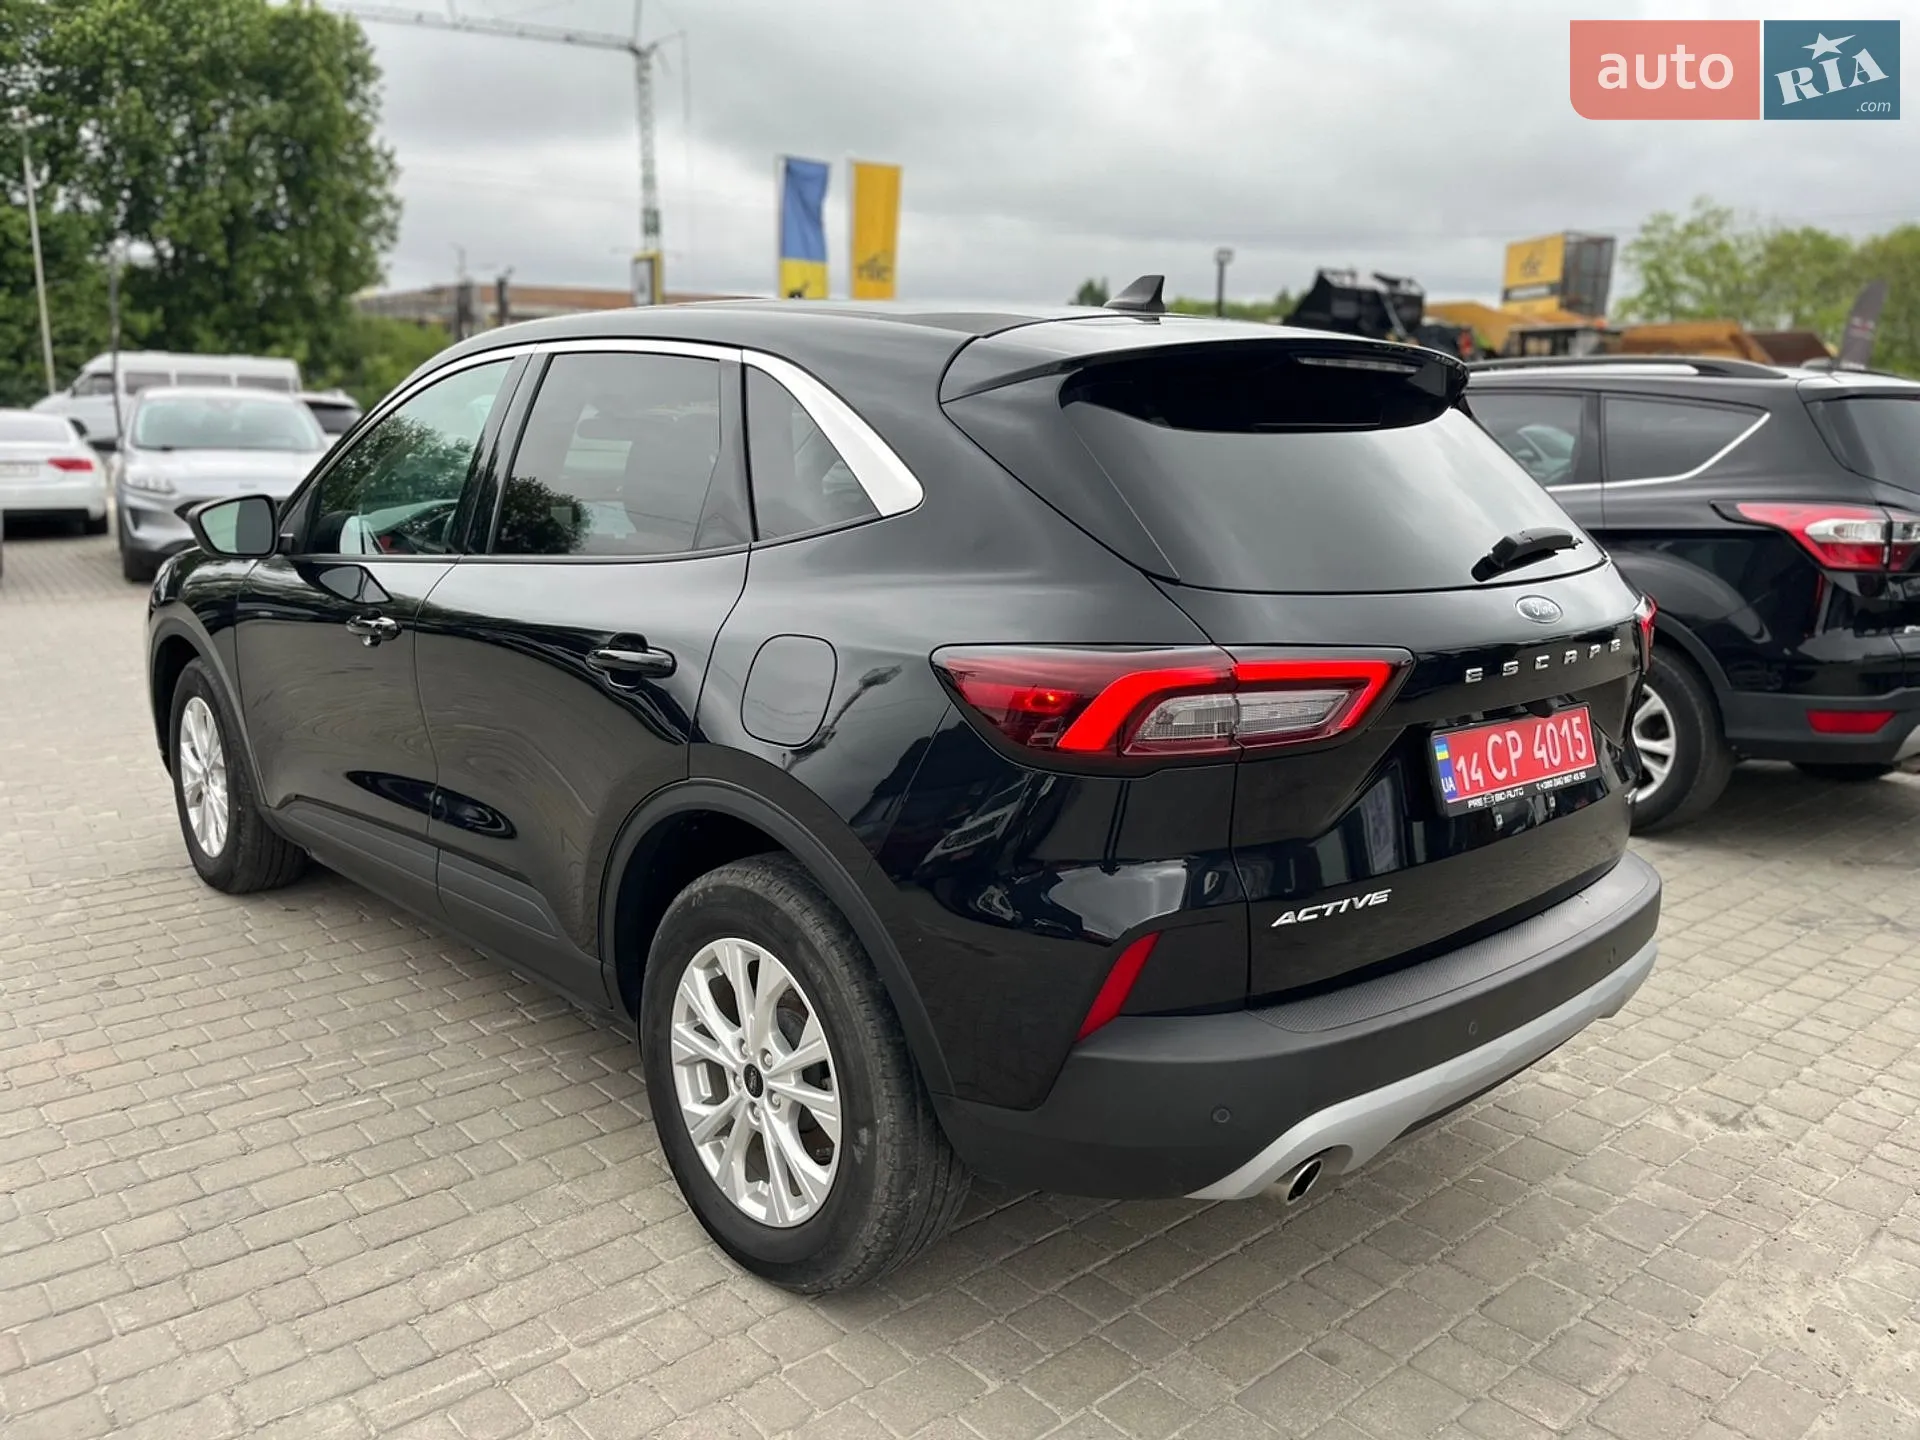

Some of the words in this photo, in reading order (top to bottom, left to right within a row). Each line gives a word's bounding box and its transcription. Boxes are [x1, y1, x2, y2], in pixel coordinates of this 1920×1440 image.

[1465, 638, 1621, 684] ESCAPE
[1455, 752, 1485, 791] 14
[1486, 730, 1523, 781] CP
[1533, 716, 1587, 769] 4015
[1441, 776, 1456, 793] UA
[1270, 888, 1392, 927] ACTIVE
